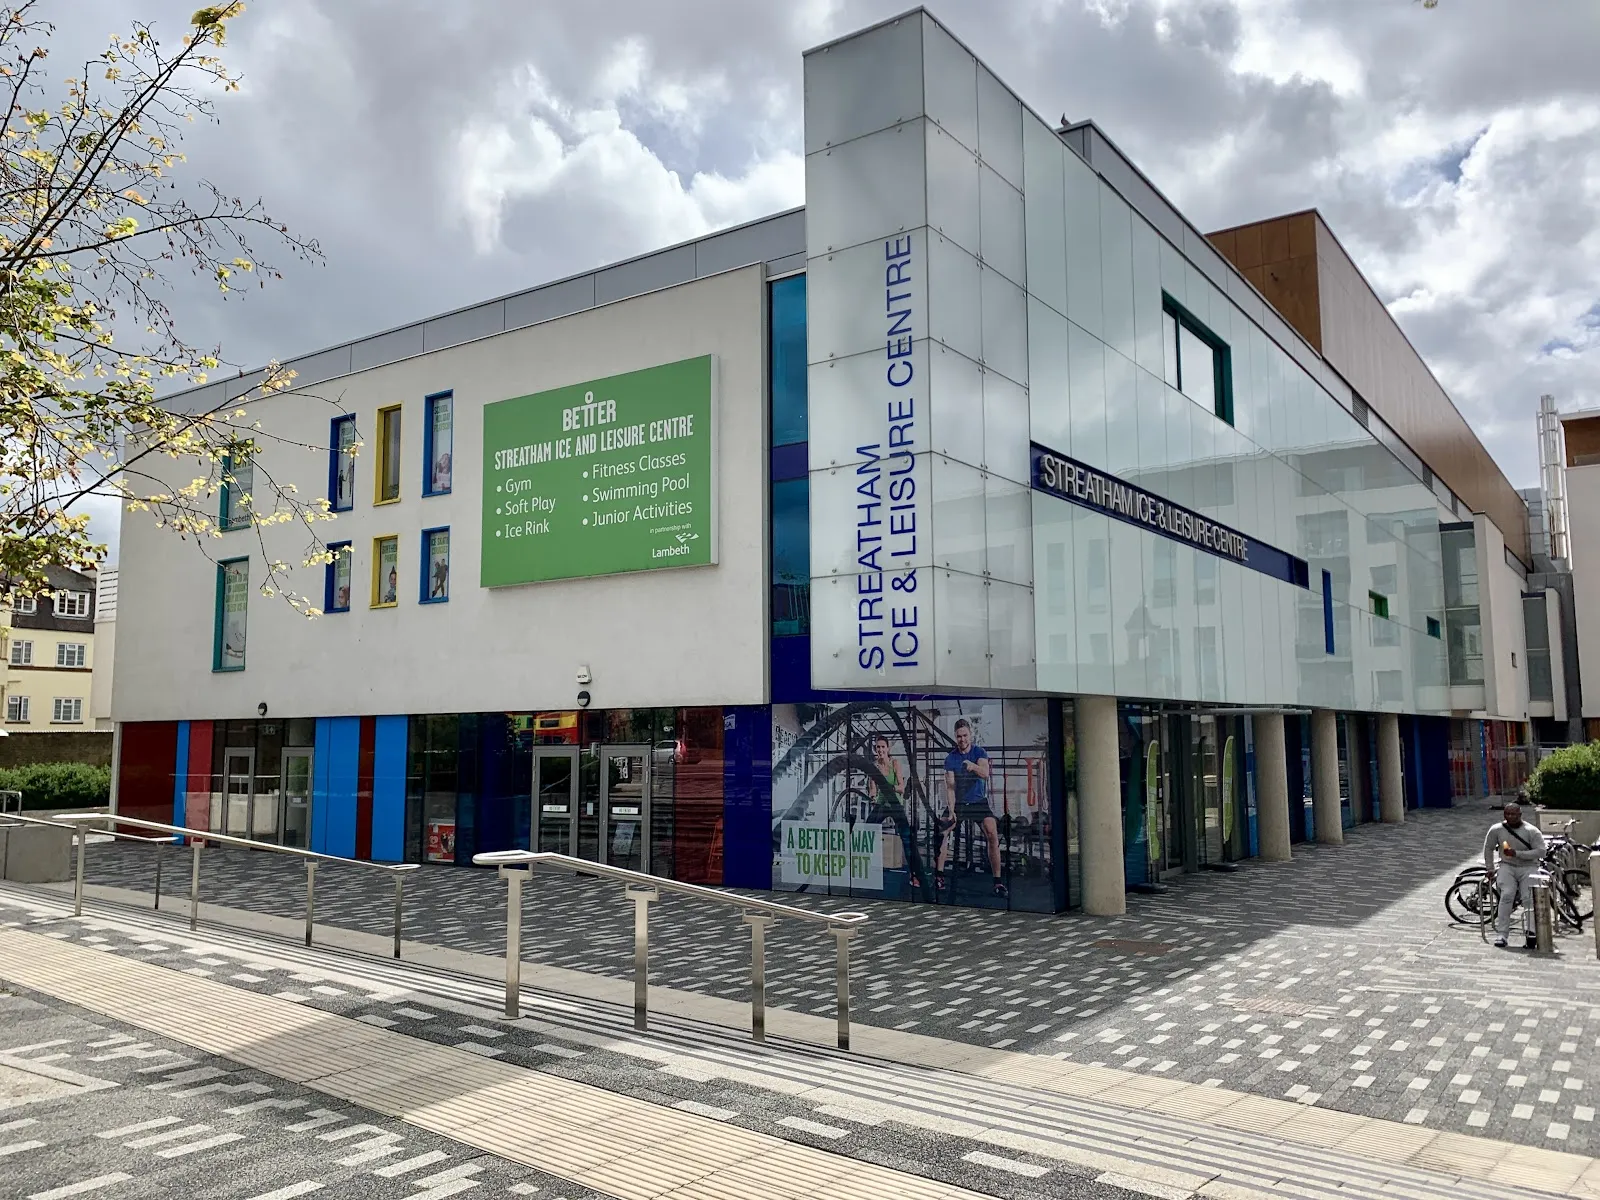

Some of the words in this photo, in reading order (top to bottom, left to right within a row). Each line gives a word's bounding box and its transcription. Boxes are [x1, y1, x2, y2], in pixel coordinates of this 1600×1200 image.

[886, 235, 914, 387] CENTRE
[562, 399, 617, 432] BETTER
[494, 441, 552, 471] STREATHAM
[555, 436, 572, 460] ICE
[575, 432, 597, 457] AND
[600, 423, 646, 452] LEISURE
[649, 414, 694, 443] CENTRE
[592, 461, 636, 480] Fitness
[638, 452, 686, 472] Classes
[888, 398, 916, 556] LEISURE
[505, 477, 532, 496] Gym
[592, 480, 658, 503] Swimming
[662, 472, 690, 492] Pool
[504, 498, 529, 516] Soft
[531, 496, 556, 514] Play
[592, 508, 630, 527] Junior
[632, 500, 692, 522] Activities
[1041, 453, 1133, 518] STREATHAM
[1136, 493, 1157, 526] ICE
[1158, 502, 1168, 530] &
[1168, 506, 1212, 547] LEISURE
[1212, 526, 1248, 561] CENTRE
[504, 523, 522, 538] Ice
[525, 519, 550, 536] Rink
[655, 524, 680, 534] partnership
[652, 543, 690, 558] Lambeth
[856, 444, 884, 670] STREATHAM
[891, 568, 917, 593] &
[892, 606, 918, 667] ICE
[786, 828, 794, 849] A
[800, 828, 846, 852] BETTER
[850, 830, 876, 854] WAY
[795, 852, 811, 876] TO
[813, 853, 847, 878] KEEP
[851, 856, 870, 880] FIT
